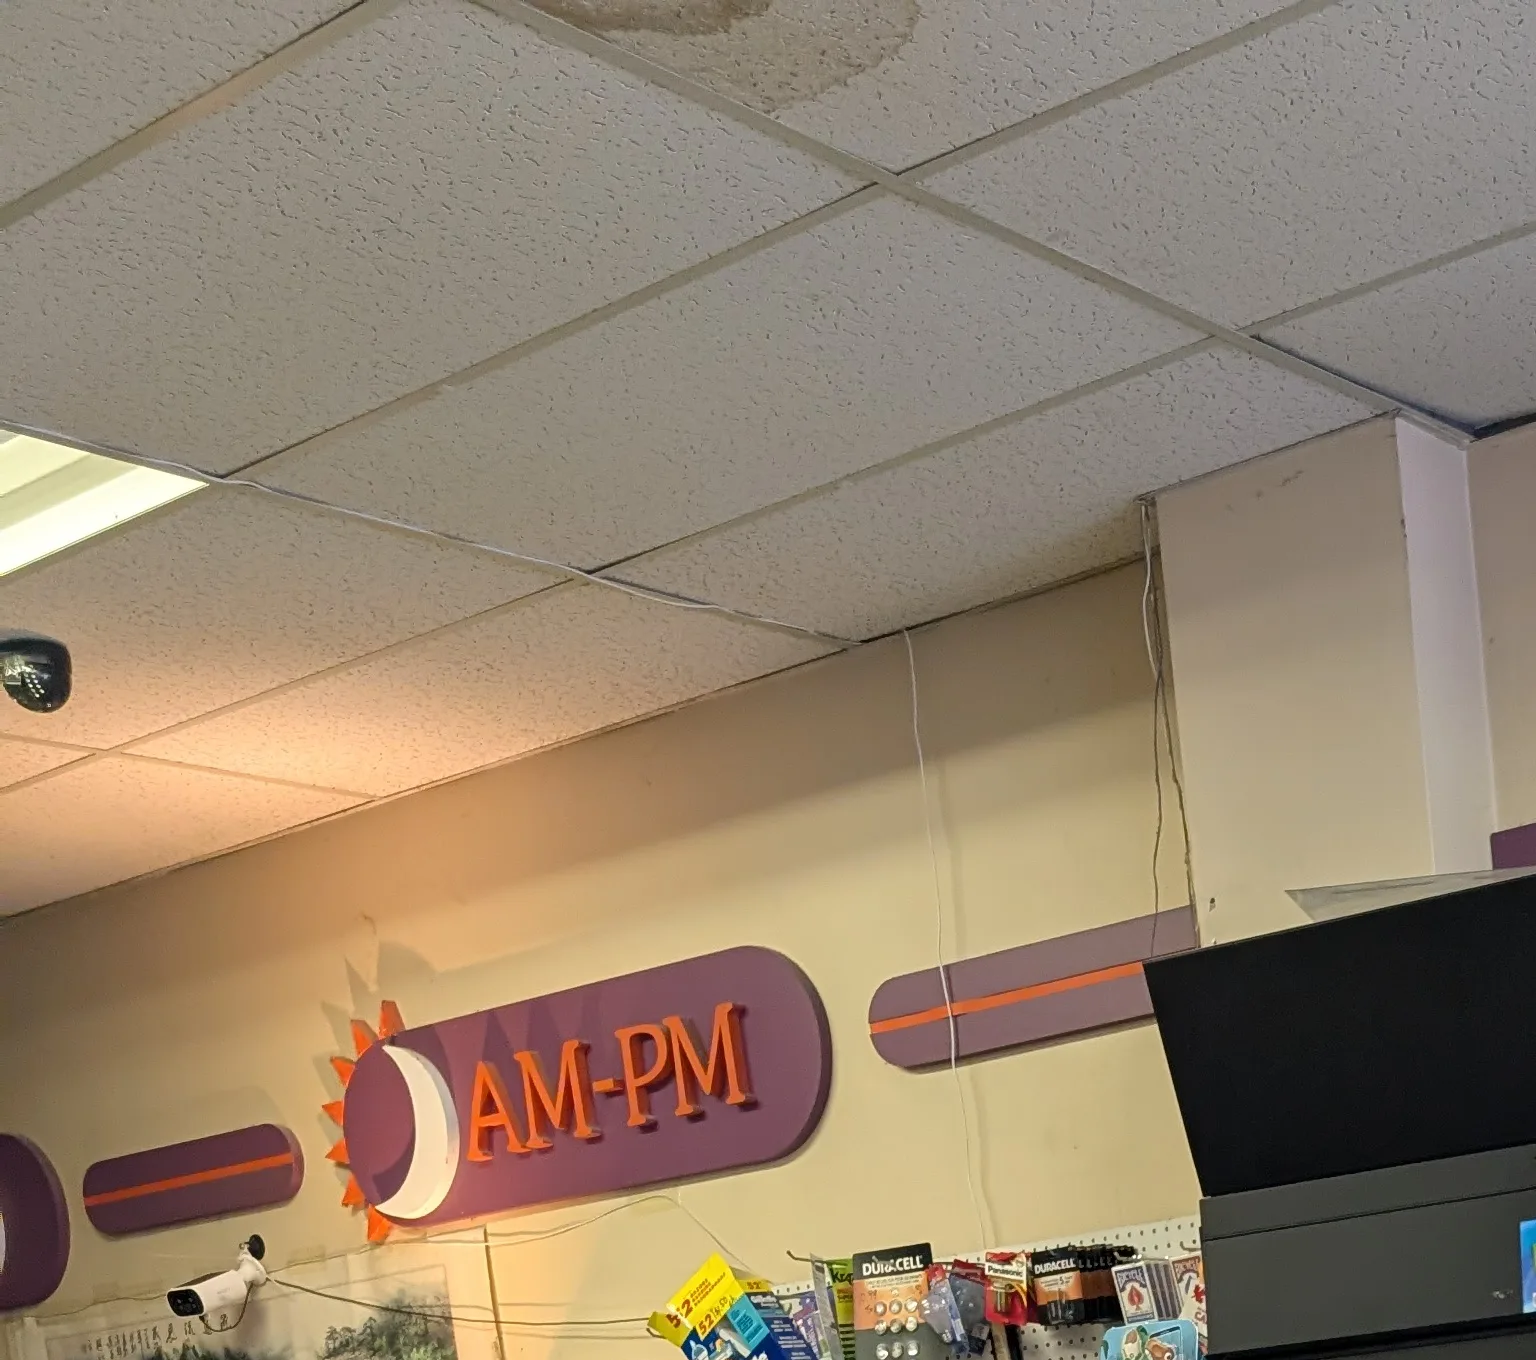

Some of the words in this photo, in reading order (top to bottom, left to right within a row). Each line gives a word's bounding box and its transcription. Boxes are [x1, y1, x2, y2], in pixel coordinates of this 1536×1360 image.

[467, 1003, 749, 1161] AM-PM
[861, 1255, 924, 1276] DURACELL
[1034, 1258, 1076, 1275] DURACELL
